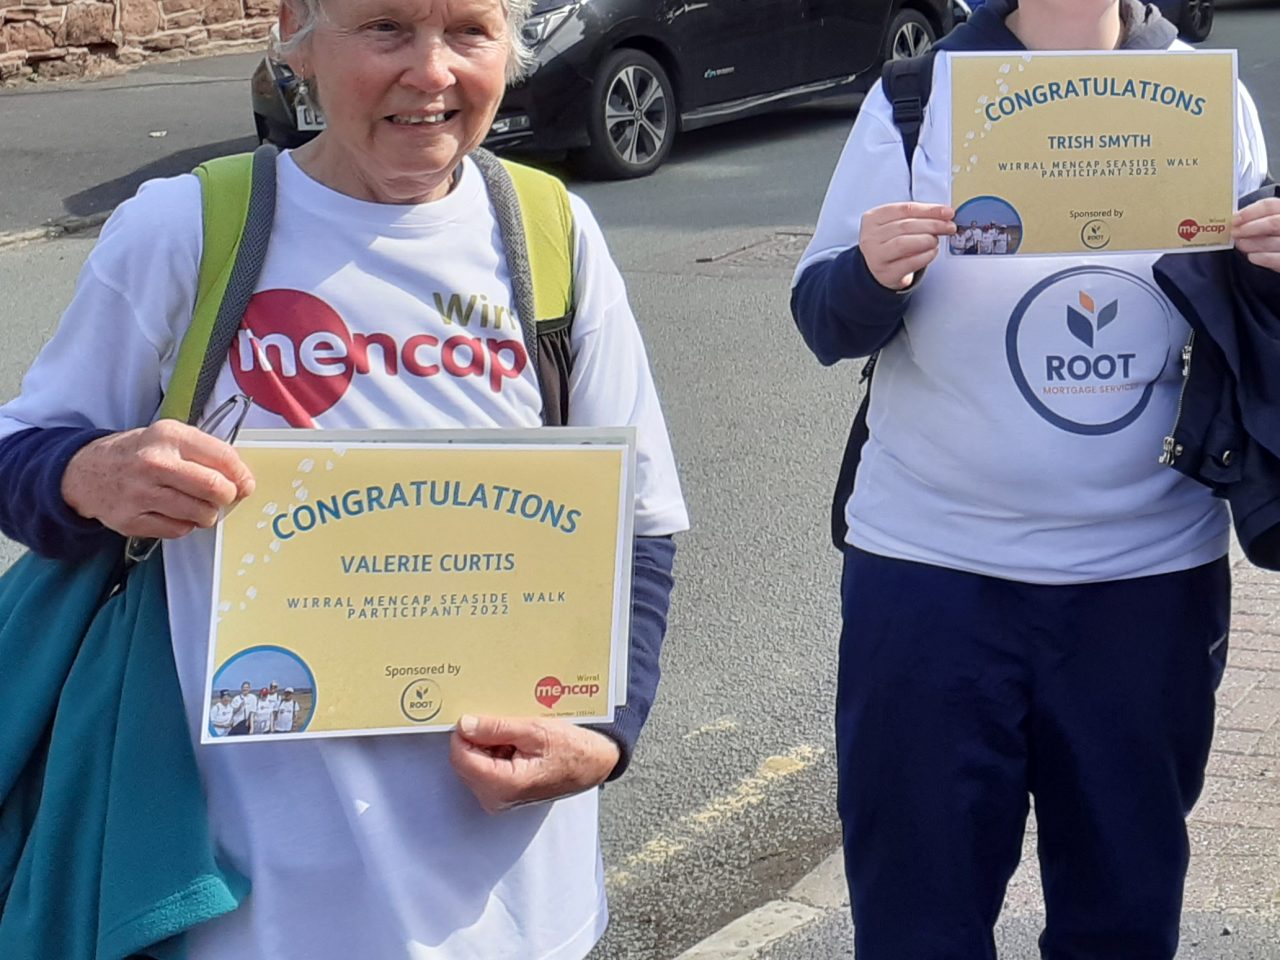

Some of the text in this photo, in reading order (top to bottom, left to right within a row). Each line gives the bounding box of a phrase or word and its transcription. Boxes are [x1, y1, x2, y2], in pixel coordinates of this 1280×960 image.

[985, 77, 1206, 122] CONGRATULATIONS
[1048, 134, 1151, 149] TRISH SMYTH
[998, 158, 1199, 171] WIRRAL MENCAP SEASIDE WALK
[1042, 167, 1157, 178] PARTICIPANT 2022
[1069, 209, 1124, 219] Sponsored by
[1179, 224, 1226, 234] mencap
[238, 329, 528, 392] mencap
[1046, 354, 1136, 380] ROOT
[1043, 384, 1097, 394] MORTGAGE
[271, 480, 582, 540] CONGRATULATIONS
[340, 553, 515, 574] VALERIE CURTIS
[287, 591, 566, 608] WIRRAL MENCAP SEASIDE WALK
[347, 604, 509, 619] PARTICIPANT 2022
[385, 663, 461, 678] Sponsored by
[577, 674, 600, 682] Wirral
[537, 683, 600, 698] mencap
[409, 701, 433, 709] ROOT
